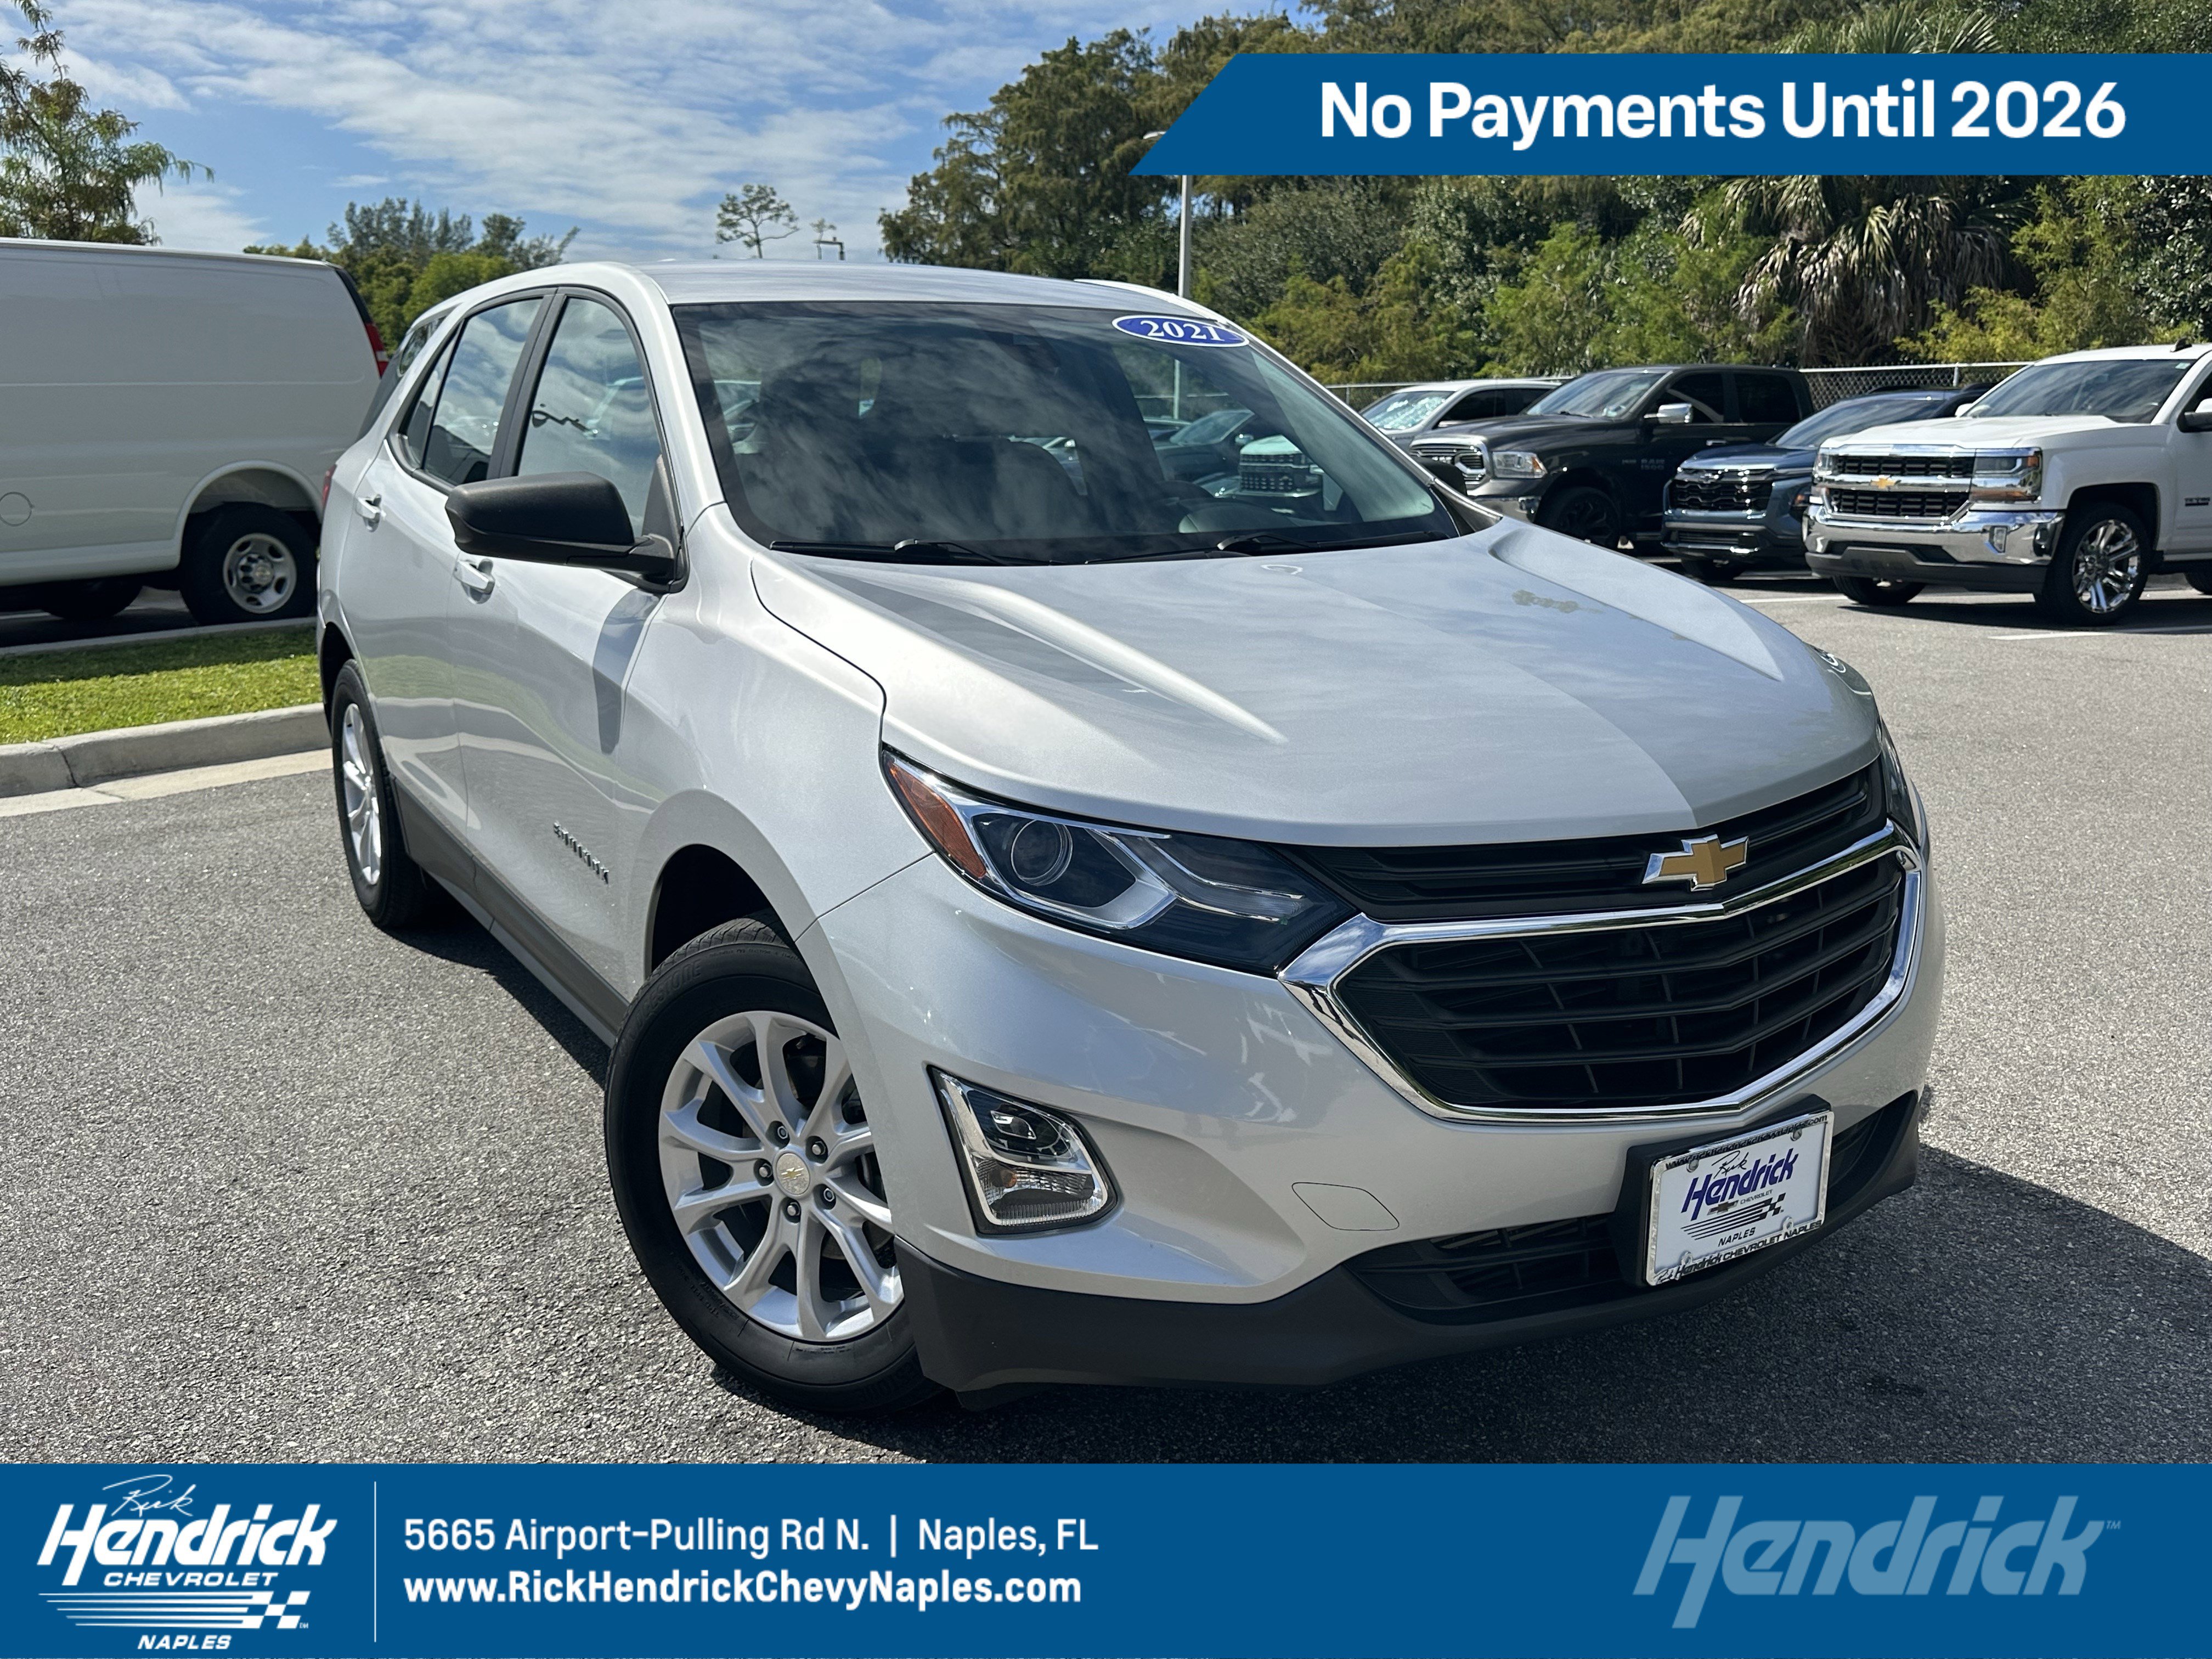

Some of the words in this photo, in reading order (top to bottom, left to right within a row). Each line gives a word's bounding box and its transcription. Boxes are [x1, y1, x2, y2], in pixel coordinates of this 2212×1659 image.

[1140, 320, 1225, 342] 2021
[1680, 1147, 1799, 1221] Hendrick
[1740, 1189, 1773, 1205] CHEVROLET
[1718, 1227, 1756, 1248] NAPLES
[1723, 1234, 1782, 1261] CHEVROLET
[1784, 1219, 1822, 1240] NAPLES
